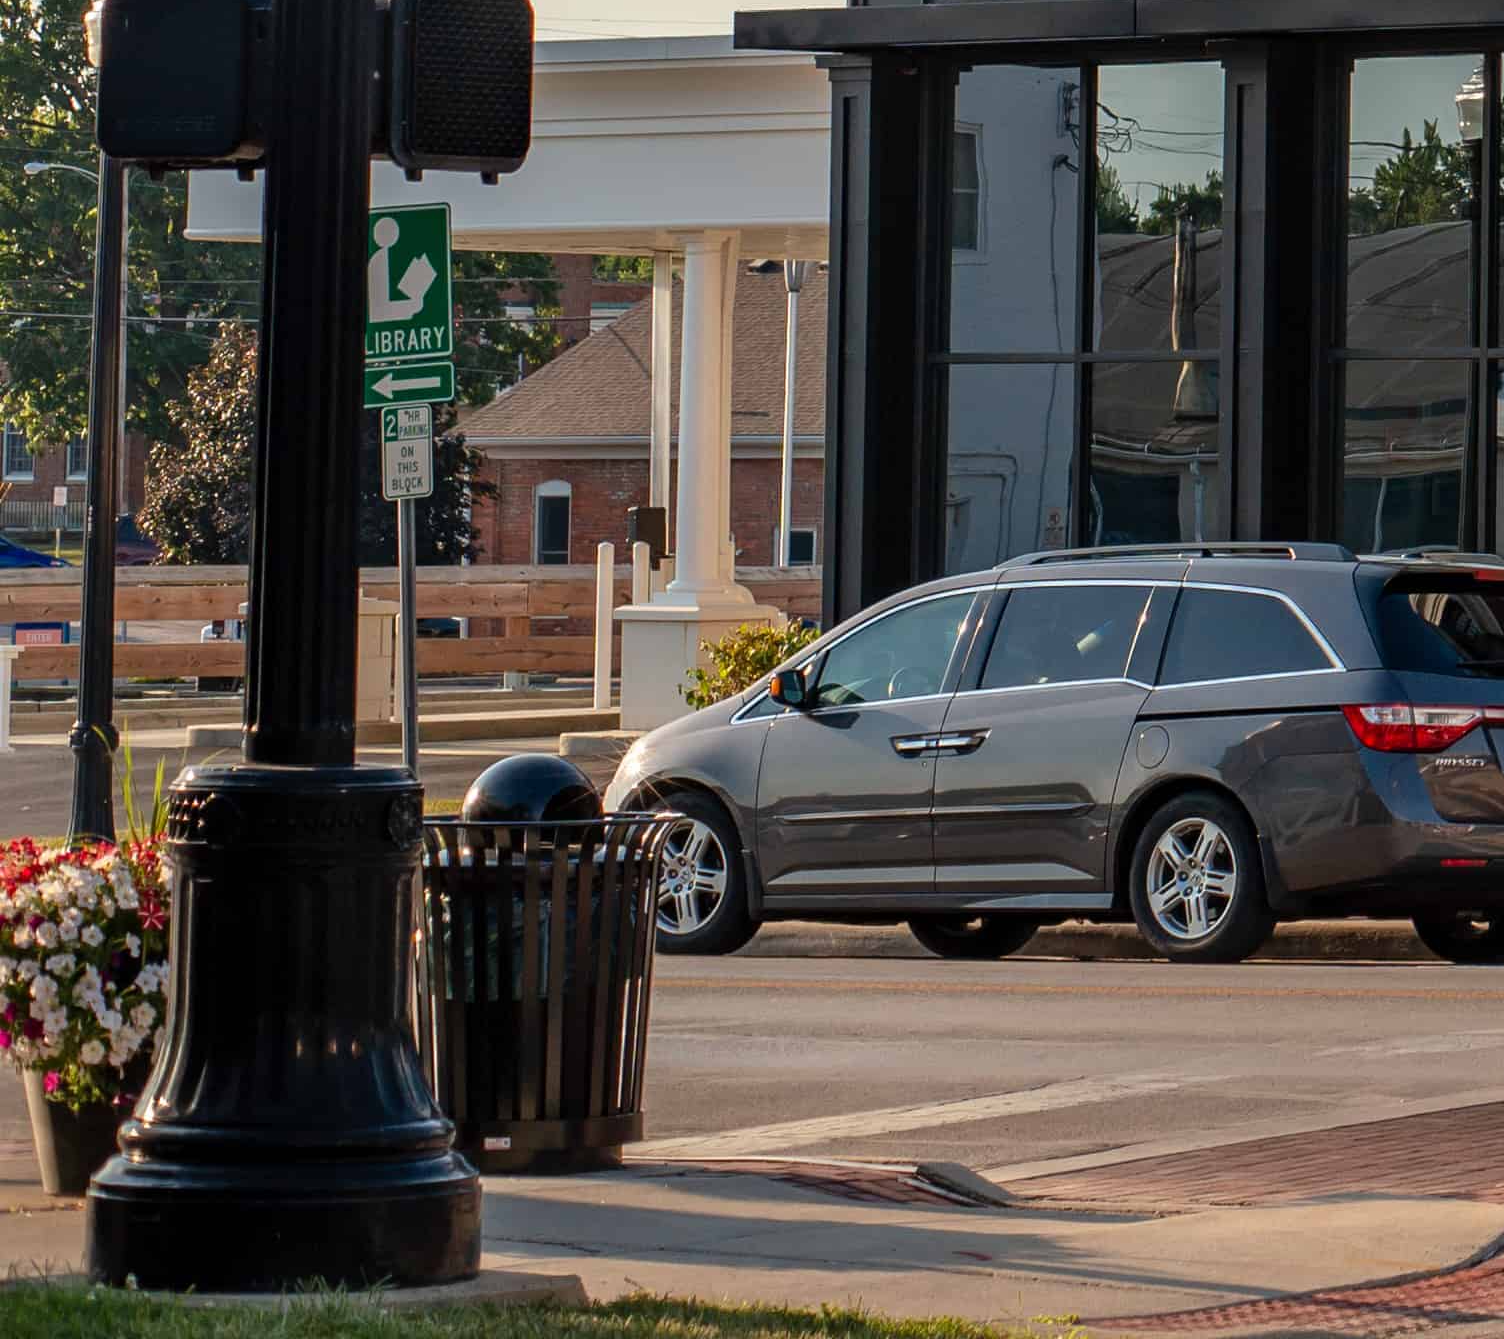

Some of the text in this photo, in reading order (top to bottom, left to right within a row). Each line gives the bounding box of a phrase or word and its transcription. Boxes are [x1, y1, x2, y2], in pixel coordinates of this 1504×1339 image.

[365, 326, 445, 355] LIBRARY
[385, 415, 397, 437] 2
[400, 445, 415, 458] ON
[397, 461, 418, 474] THIS
[392, 476, 424, 492] BLOCK
